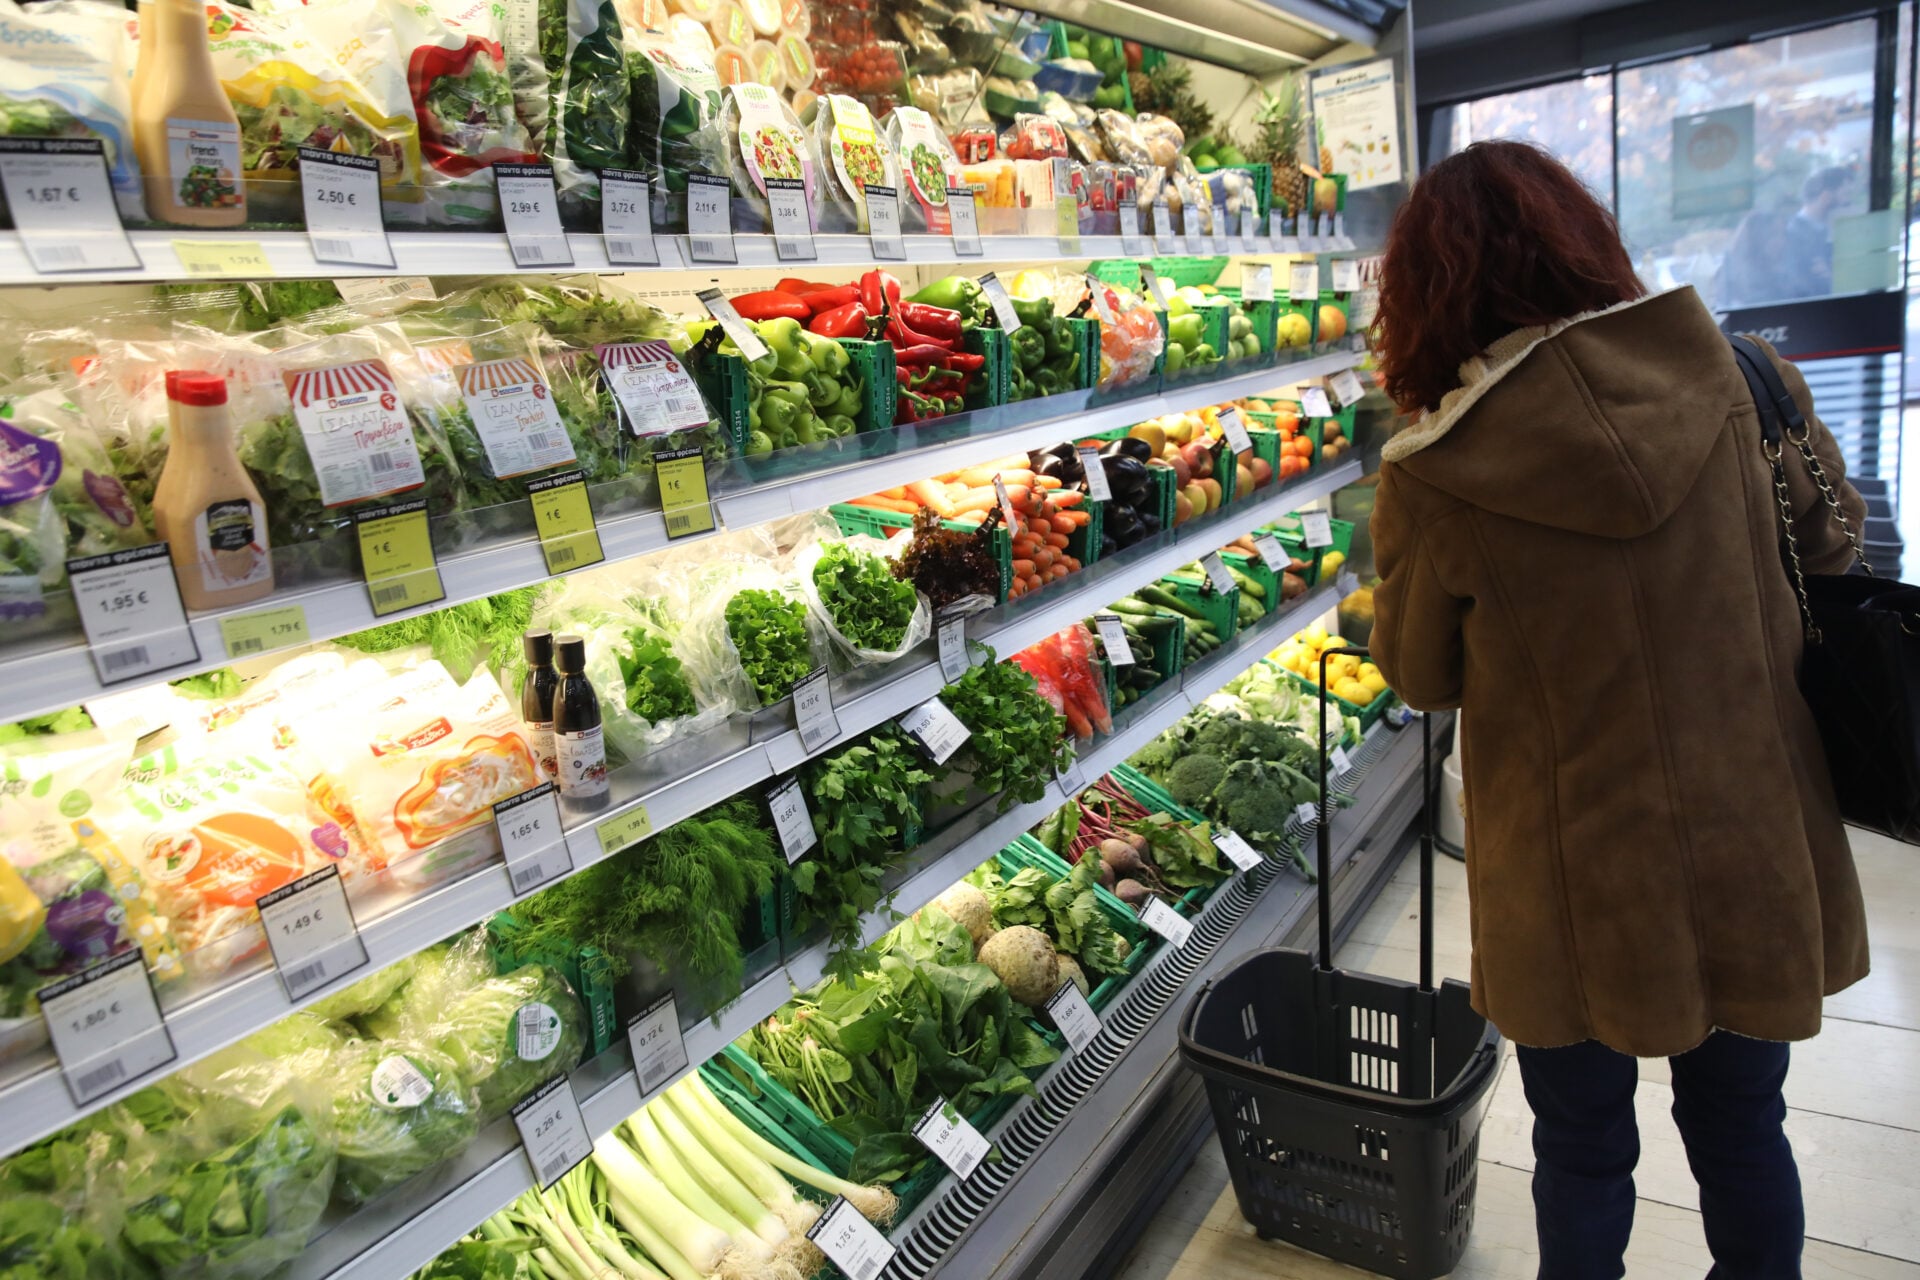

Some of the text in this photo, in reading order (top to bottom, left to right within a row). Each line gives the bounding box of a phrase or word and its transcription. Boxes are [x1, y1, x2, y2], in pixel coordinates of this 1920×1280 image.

[190, 143, 219, 156] french
[26, 187, 80, 204] 1,67 €
[317, 188, 357, 206] 2,50 €
[511, 202, 541, 214] 2,99 €
[611, 202, 636, 214] 3,72 €
[695, 202, 717, 214] 2,11 €
[490, 398, 542, 418] ΣΑΛΑΤΑ
[326, 409, 390, 433] ΣΑΛΑΤΑ
[667, 480, 673, 490] 1
[545, 511, 551, 521] 1
[373, 544, 380, 555] 1
[100, 590, 149, 614] 1,95 €
[271, 621, 301, 634] 1,79 €
[801, 697, 814, 711] 0,70
[780, 807, 792, 823] 0,55
[511, 819, 541, 840] 1,65 €
[283, 908, 323, 935] 1,49 €
[596, 1004, 606, 1037] LL4314
[640, 1024, 664, 1047] 0,72 €
[535, 1110, 563, 1138] 2,29 €
[835, 1224, 856, 1249] 1,75 €
